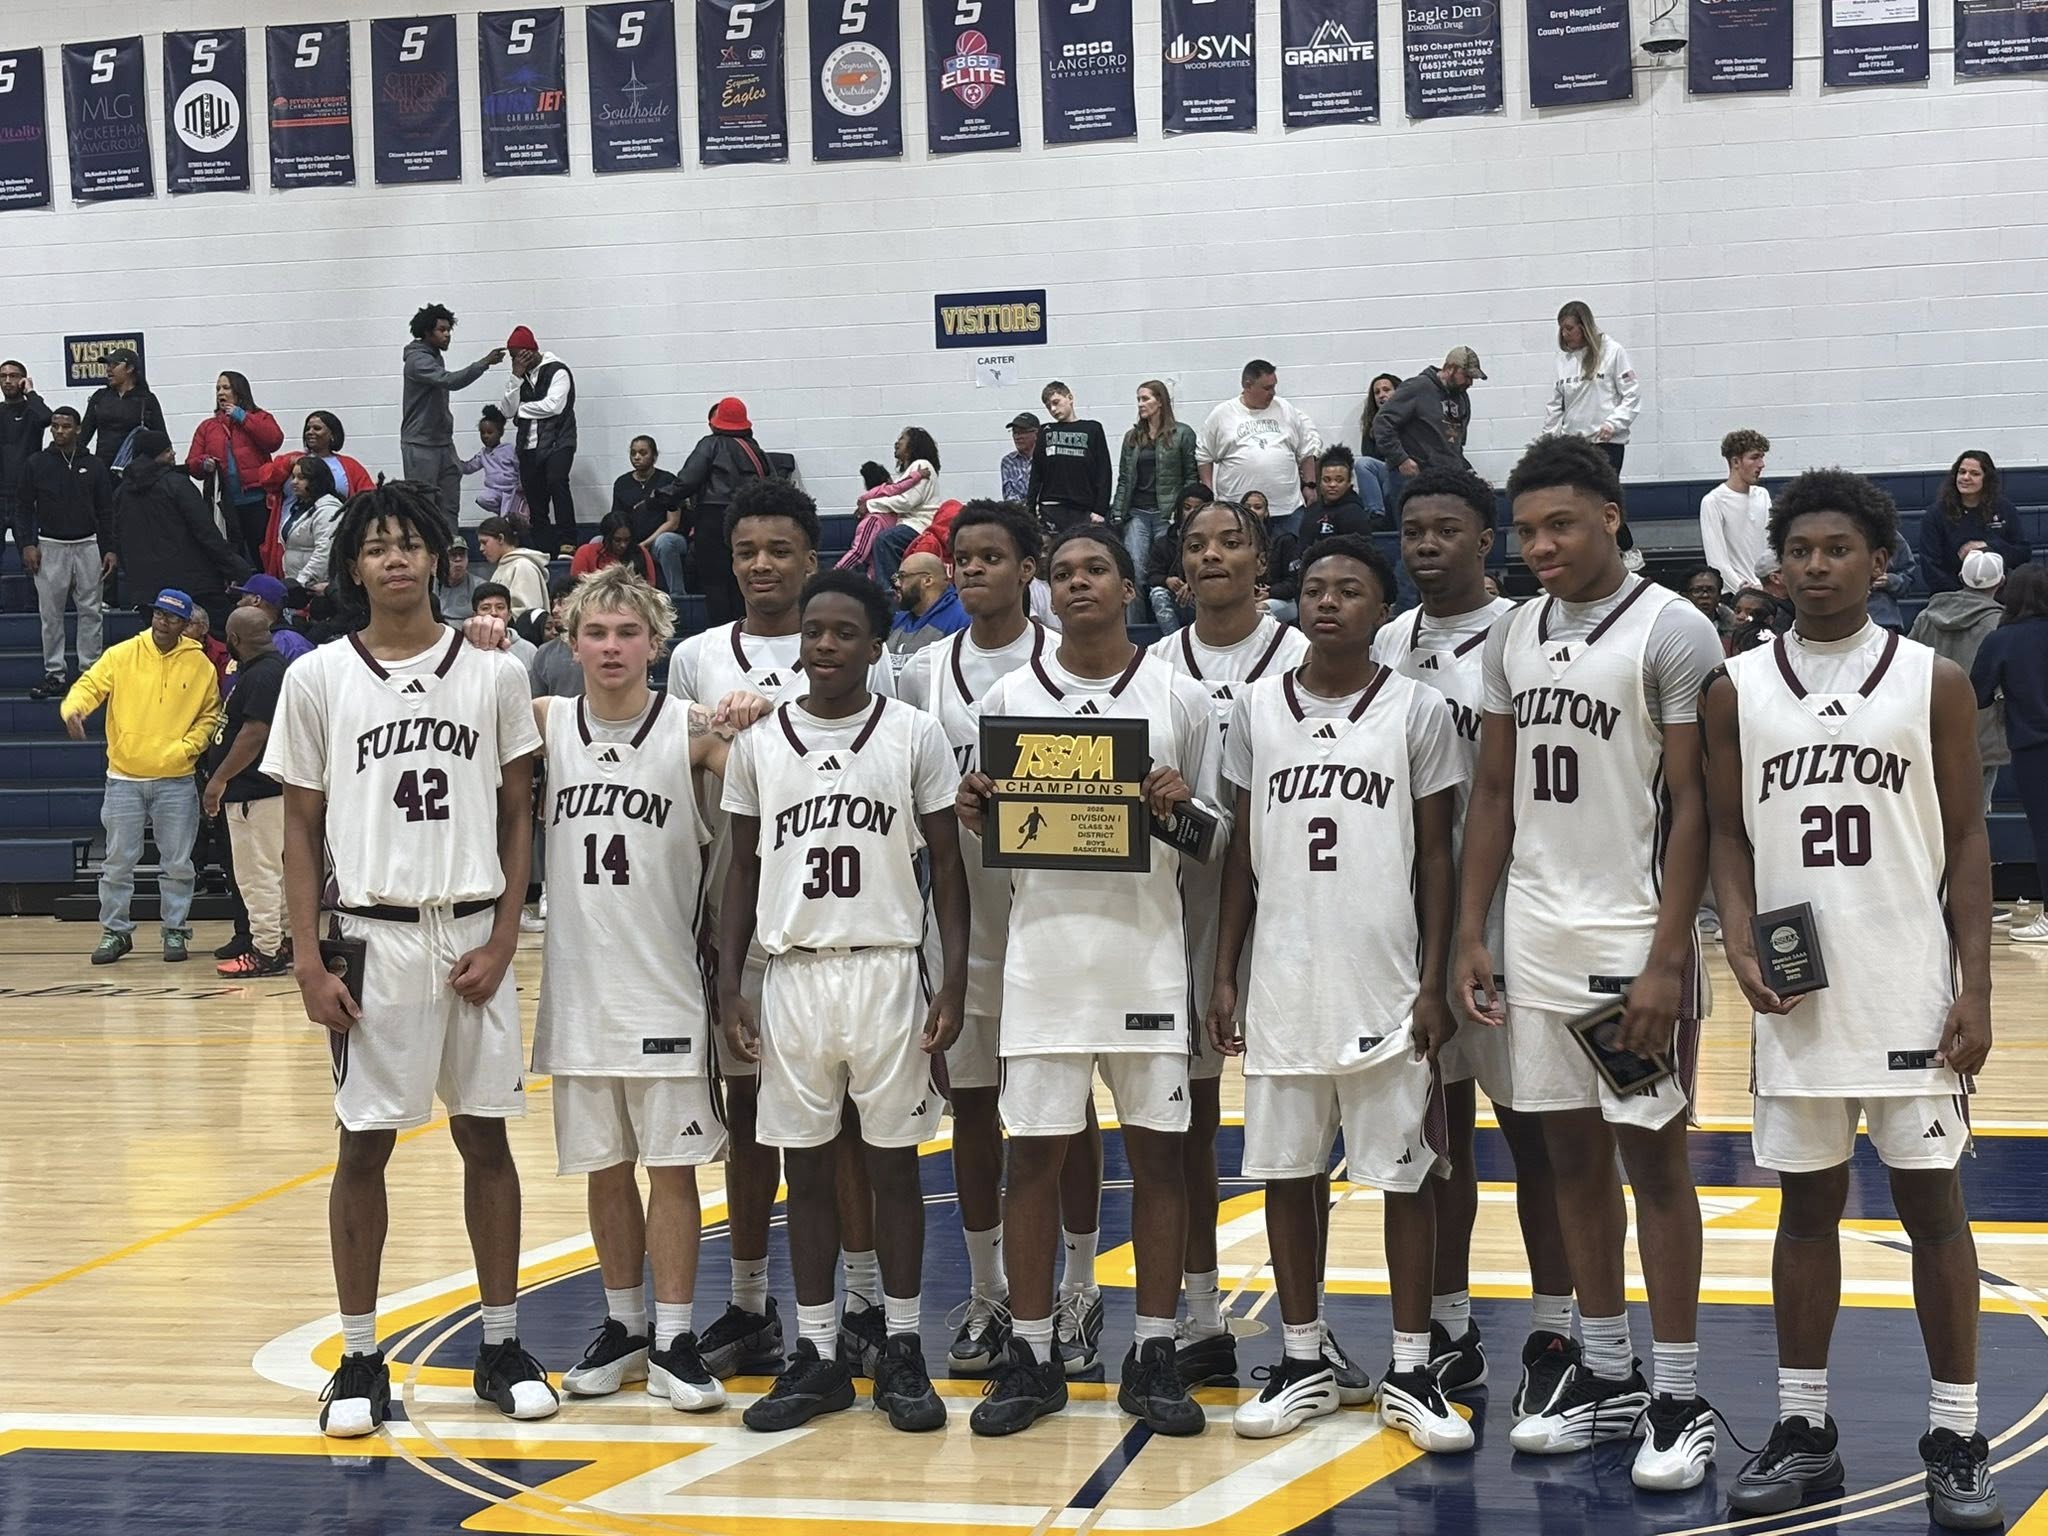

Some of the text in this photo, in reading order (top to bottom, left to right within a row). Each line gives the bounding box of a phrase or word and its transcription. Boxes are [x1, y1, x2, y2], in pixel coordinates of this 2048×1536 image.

[726, 4, 756, 40] S
[839, 0, 869, 34] S
[1407, 5, 1482, 25] Eagle Den
[1550, 6, 1602, 20] Greg Haggard
[507, 18, 536, 55] S
[616, 11, 646, 48] S
[1407, 20, 1464, 32] Discount Drug
[1537, 21, 1620, 37] County Commissioner
[294, 32, 322, 68] S
[400, 26, 429, 62] S
[1197, 33, 1252, 61] SVN
[1407, 39, 1495, 53] 11510 Chapman Hwy
[1967, 40, 1983, 48] Great
[1984, 40, 2001, 48] Ridge
[2001, 38, 2031, 46] Insurance
[191, 38, 218, 74] S
[955, 54, 989, 69] 865
[1049, 53, 1128, 72] LANGFORD
[1184, 59, 1251, 70] WOOD PROPERTIES
[1285, 45, 1375, 66] GRANITE
[1409, 48, 1492, 62] Seymour, TN 37865
[91, 48, 117, 84] S
[840, 60, 873, 74] Seymour
[1051, 66, 1127, 79] ORTHODONTICS
[1420, 68, 1485, 81] FREE DELIVERY
[941, 67, 1006, 91] ELITE
[1572, 79, 1608, 88] Commissioner
[536, 91, 563, 113] JET
[721, 86, 767, 108] Eagles
[840, 85, 877, 99] Nutrition
[83, 94, 133, 122] MLG
[507, 112, 545, 122] CAR WASH
[599, 100, 671, 121] Southside
[72, 125, 145, 142] MCKEEHAN
[941, 303, 1041, 335] VISITORS
[977, 355, 1015, 366] CARTER
[71, 363, 109, 380] STUD
[1045, 431, 1089, 450] CARTER
[356, 717, 480, 775] FULTON
[1532, 743, 1579, 804] 10
[1758, 743, 1912, 805] FULTON
[393, 768, 450, 823] 42
[1005, 781, 1124, 797] CHAMPIONS
[1267, 764, 1395, 815] FULTON
[552, 783, 673, 829] FULTON
[774, 793, 898, 852] FULTON
[1070, 813, 1116, 823] DIVISION
[1078, 823, 1103, 831] CLASS
[1077, 831, 1115, 839] DISTRICT
[1308, 817, 1338, 872] 2
[1800, 804, 1873, 868] 20
[583, 833, 630, 886] 14
[1072, 846, 1121, 854] BASKETBALL
[803, 845, 861, 900] 30
